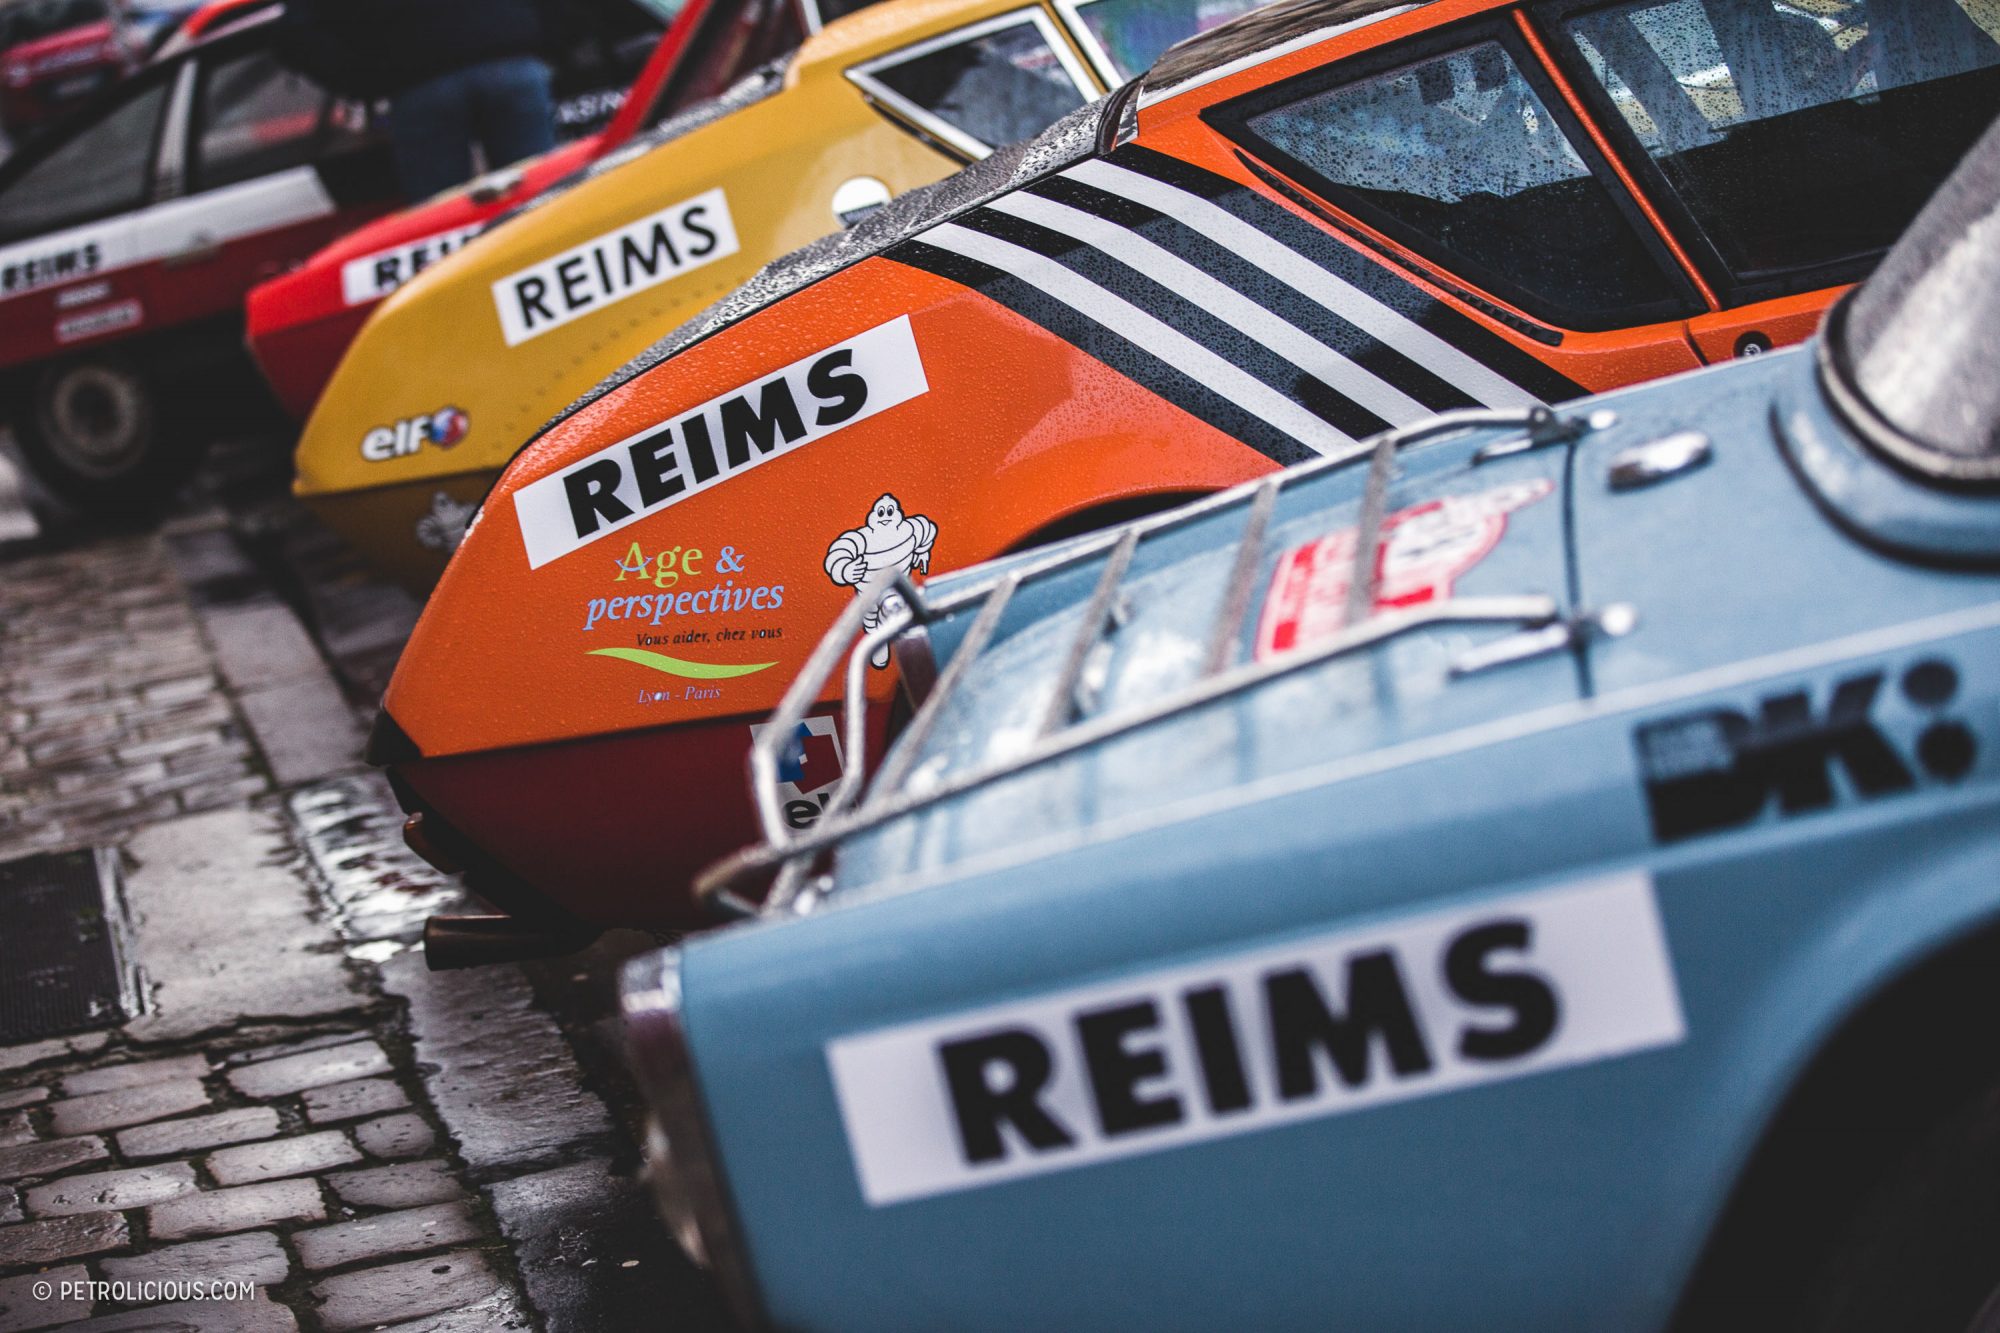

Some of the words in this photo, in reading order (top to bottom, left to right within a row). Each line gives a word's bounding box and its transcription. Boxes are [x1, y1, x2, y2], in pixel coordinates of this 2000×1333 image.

[2, 243, 100, 290] REIMS
[515, 205, 718, 330] REIMS
[361, 413, 432, 461] elf
[562, 348, 868, 539] REIMS
[614, 542, 703, 588] Age
[715, 545, 745, 574] &
[582, 580, 785, 631] perspectives
[636, 632, 669, 646] Vous
[672, 629, 711, 644] aider,
[716, 627, 746, 642] chez
[750, 626, 783, 640] vous
[638, 689, 671, 706] Lyon
[685, 686, 721, 700] Paris
[935, 918, 1562, 1167] REIMS
